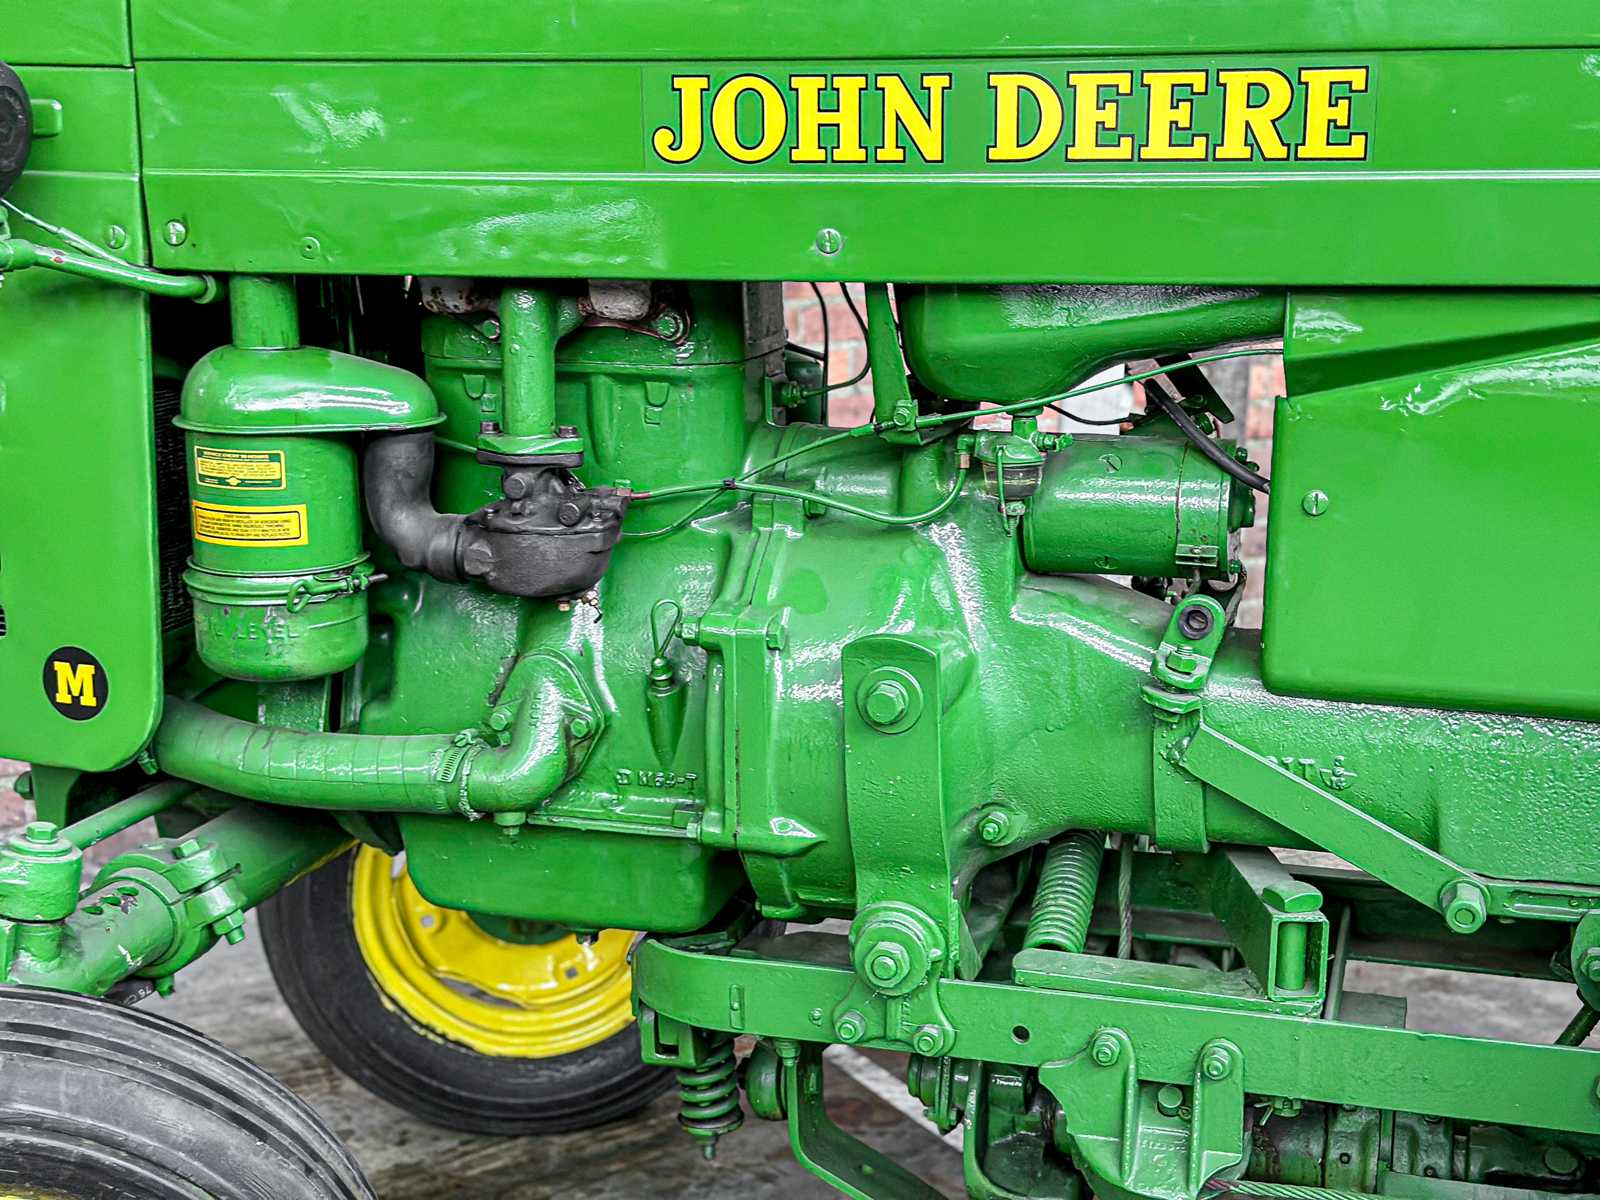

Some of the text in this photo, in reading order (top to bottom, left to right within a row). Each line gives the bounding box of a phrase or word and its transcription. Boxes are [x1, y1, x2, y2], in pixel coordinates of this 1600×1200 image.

[652, 67, 1371, 163] JOHN DEERE
[53, 660, 97, 707] M
